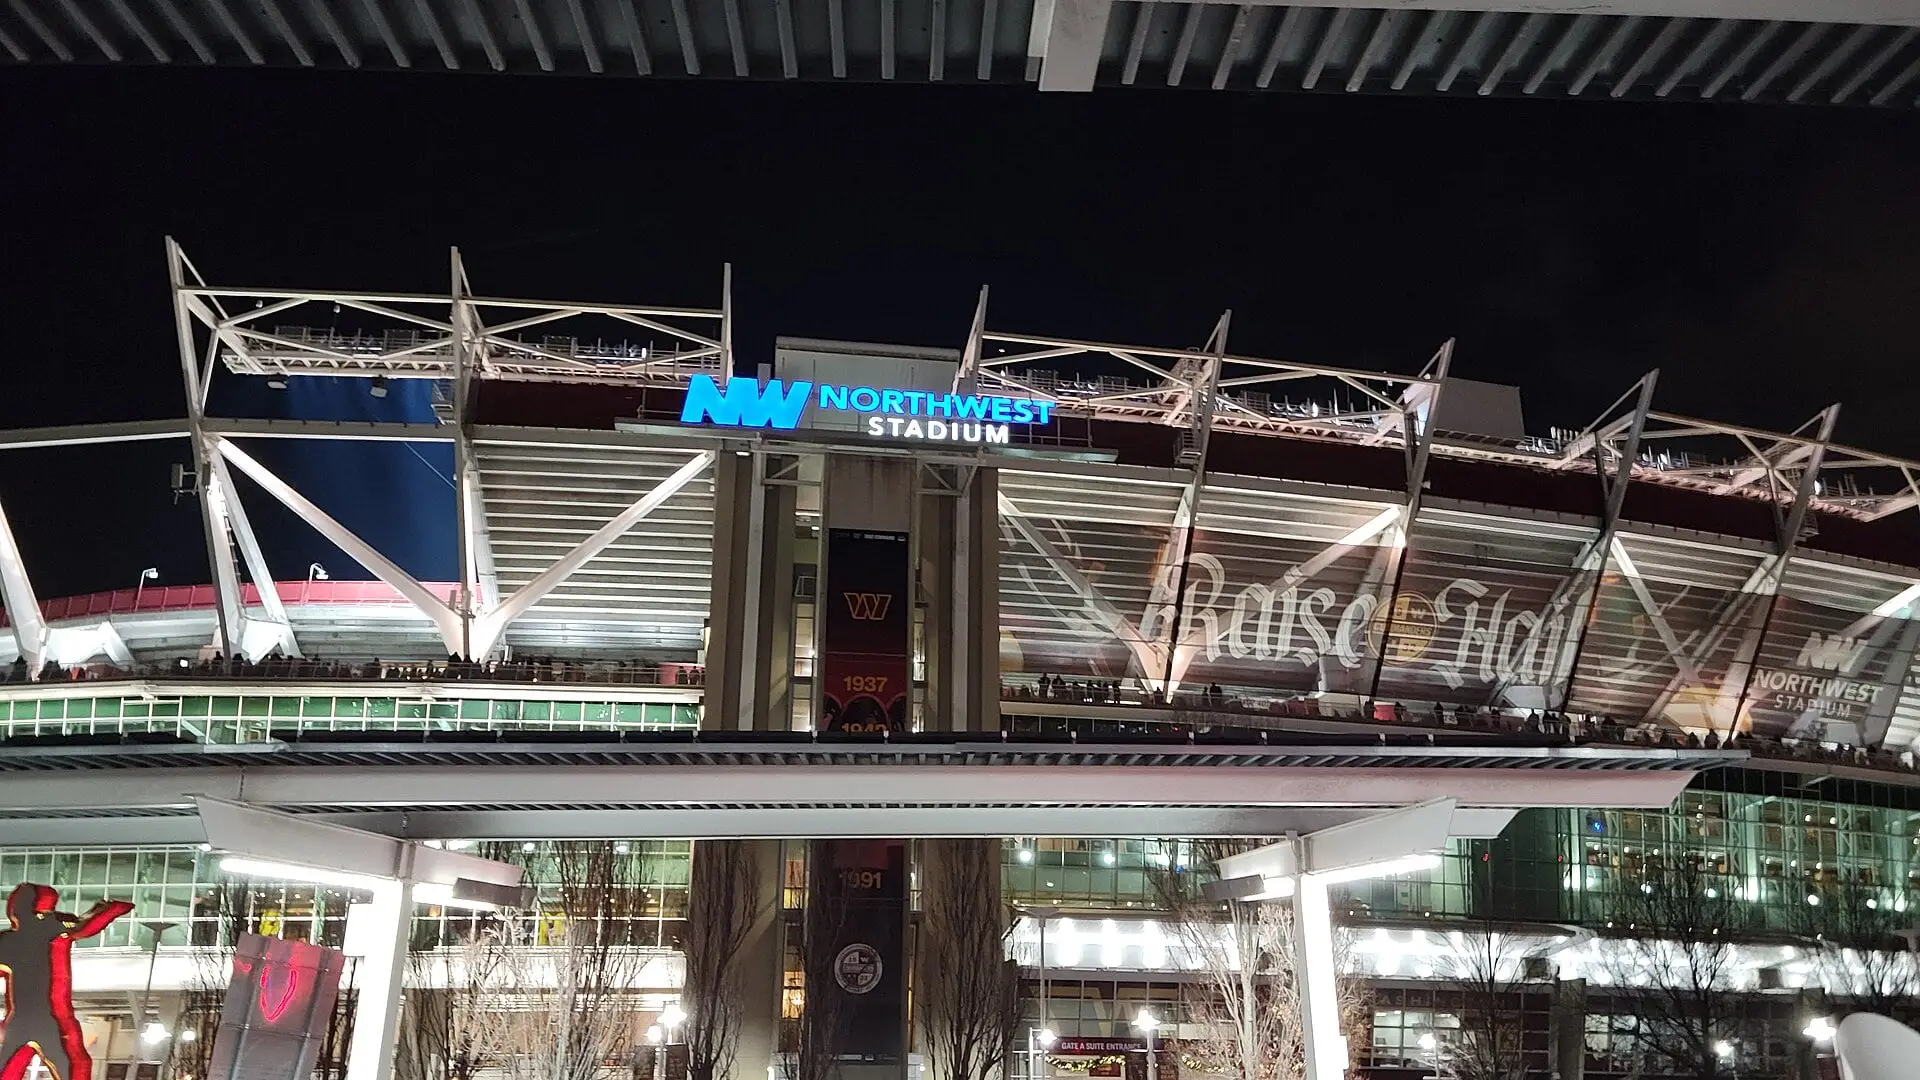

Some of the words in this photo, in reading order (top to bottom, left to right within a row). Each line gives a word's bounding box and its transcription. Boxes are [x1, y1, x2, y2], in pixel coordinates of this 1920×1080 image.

[680, 373, 814, 430] NW
[819, 384, 1056, 425] NORTHWEST
[868, 416, 1010, 444] STADIUM
[844, 592, 892, 620] W
[844, 675, 888, 692] 1937
[1753, 669, 1885, 703] NORTHWEST
[1773, 693, 1851, 718] STADIUM
[1061, 1042, 1079, 1050] GATE
[1106, 1043, 1141, 1051] ENTRANCE
